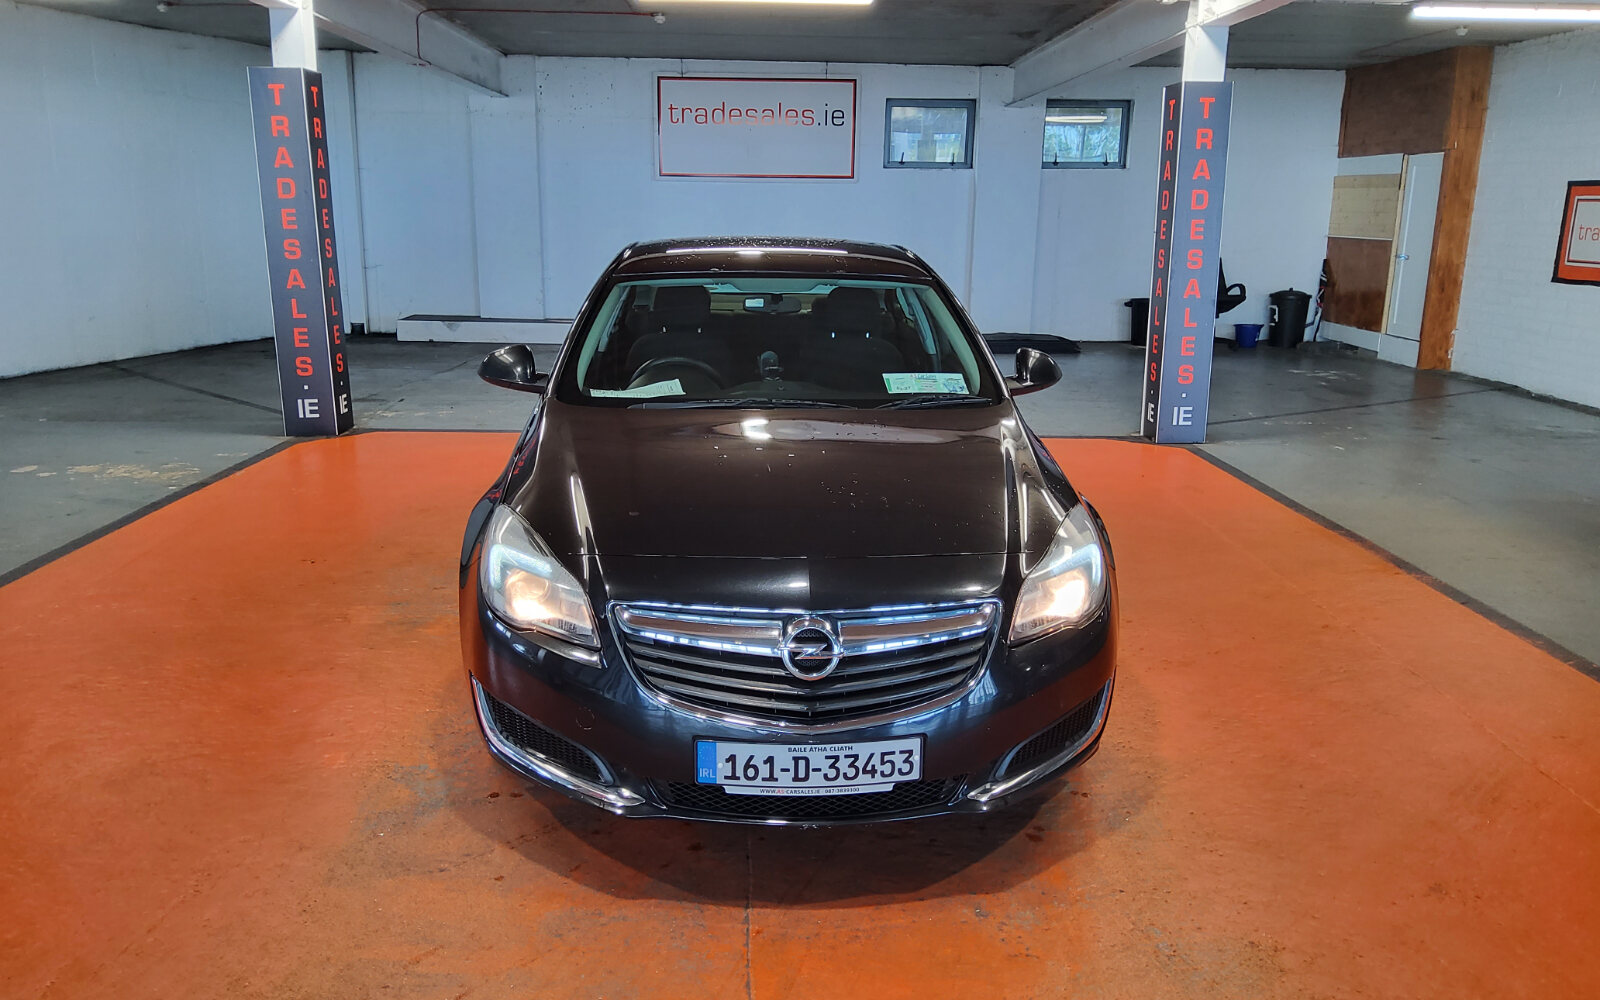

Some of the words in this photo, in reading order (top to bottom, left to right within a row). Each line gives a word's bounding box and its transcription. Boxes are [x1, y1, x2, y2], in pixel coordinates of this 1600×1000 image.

[667, 101, 845, 126] tradesales.ie
[699, 767, 716, 779] IRL
[723, 749, 915, 783] 161-D-33453
